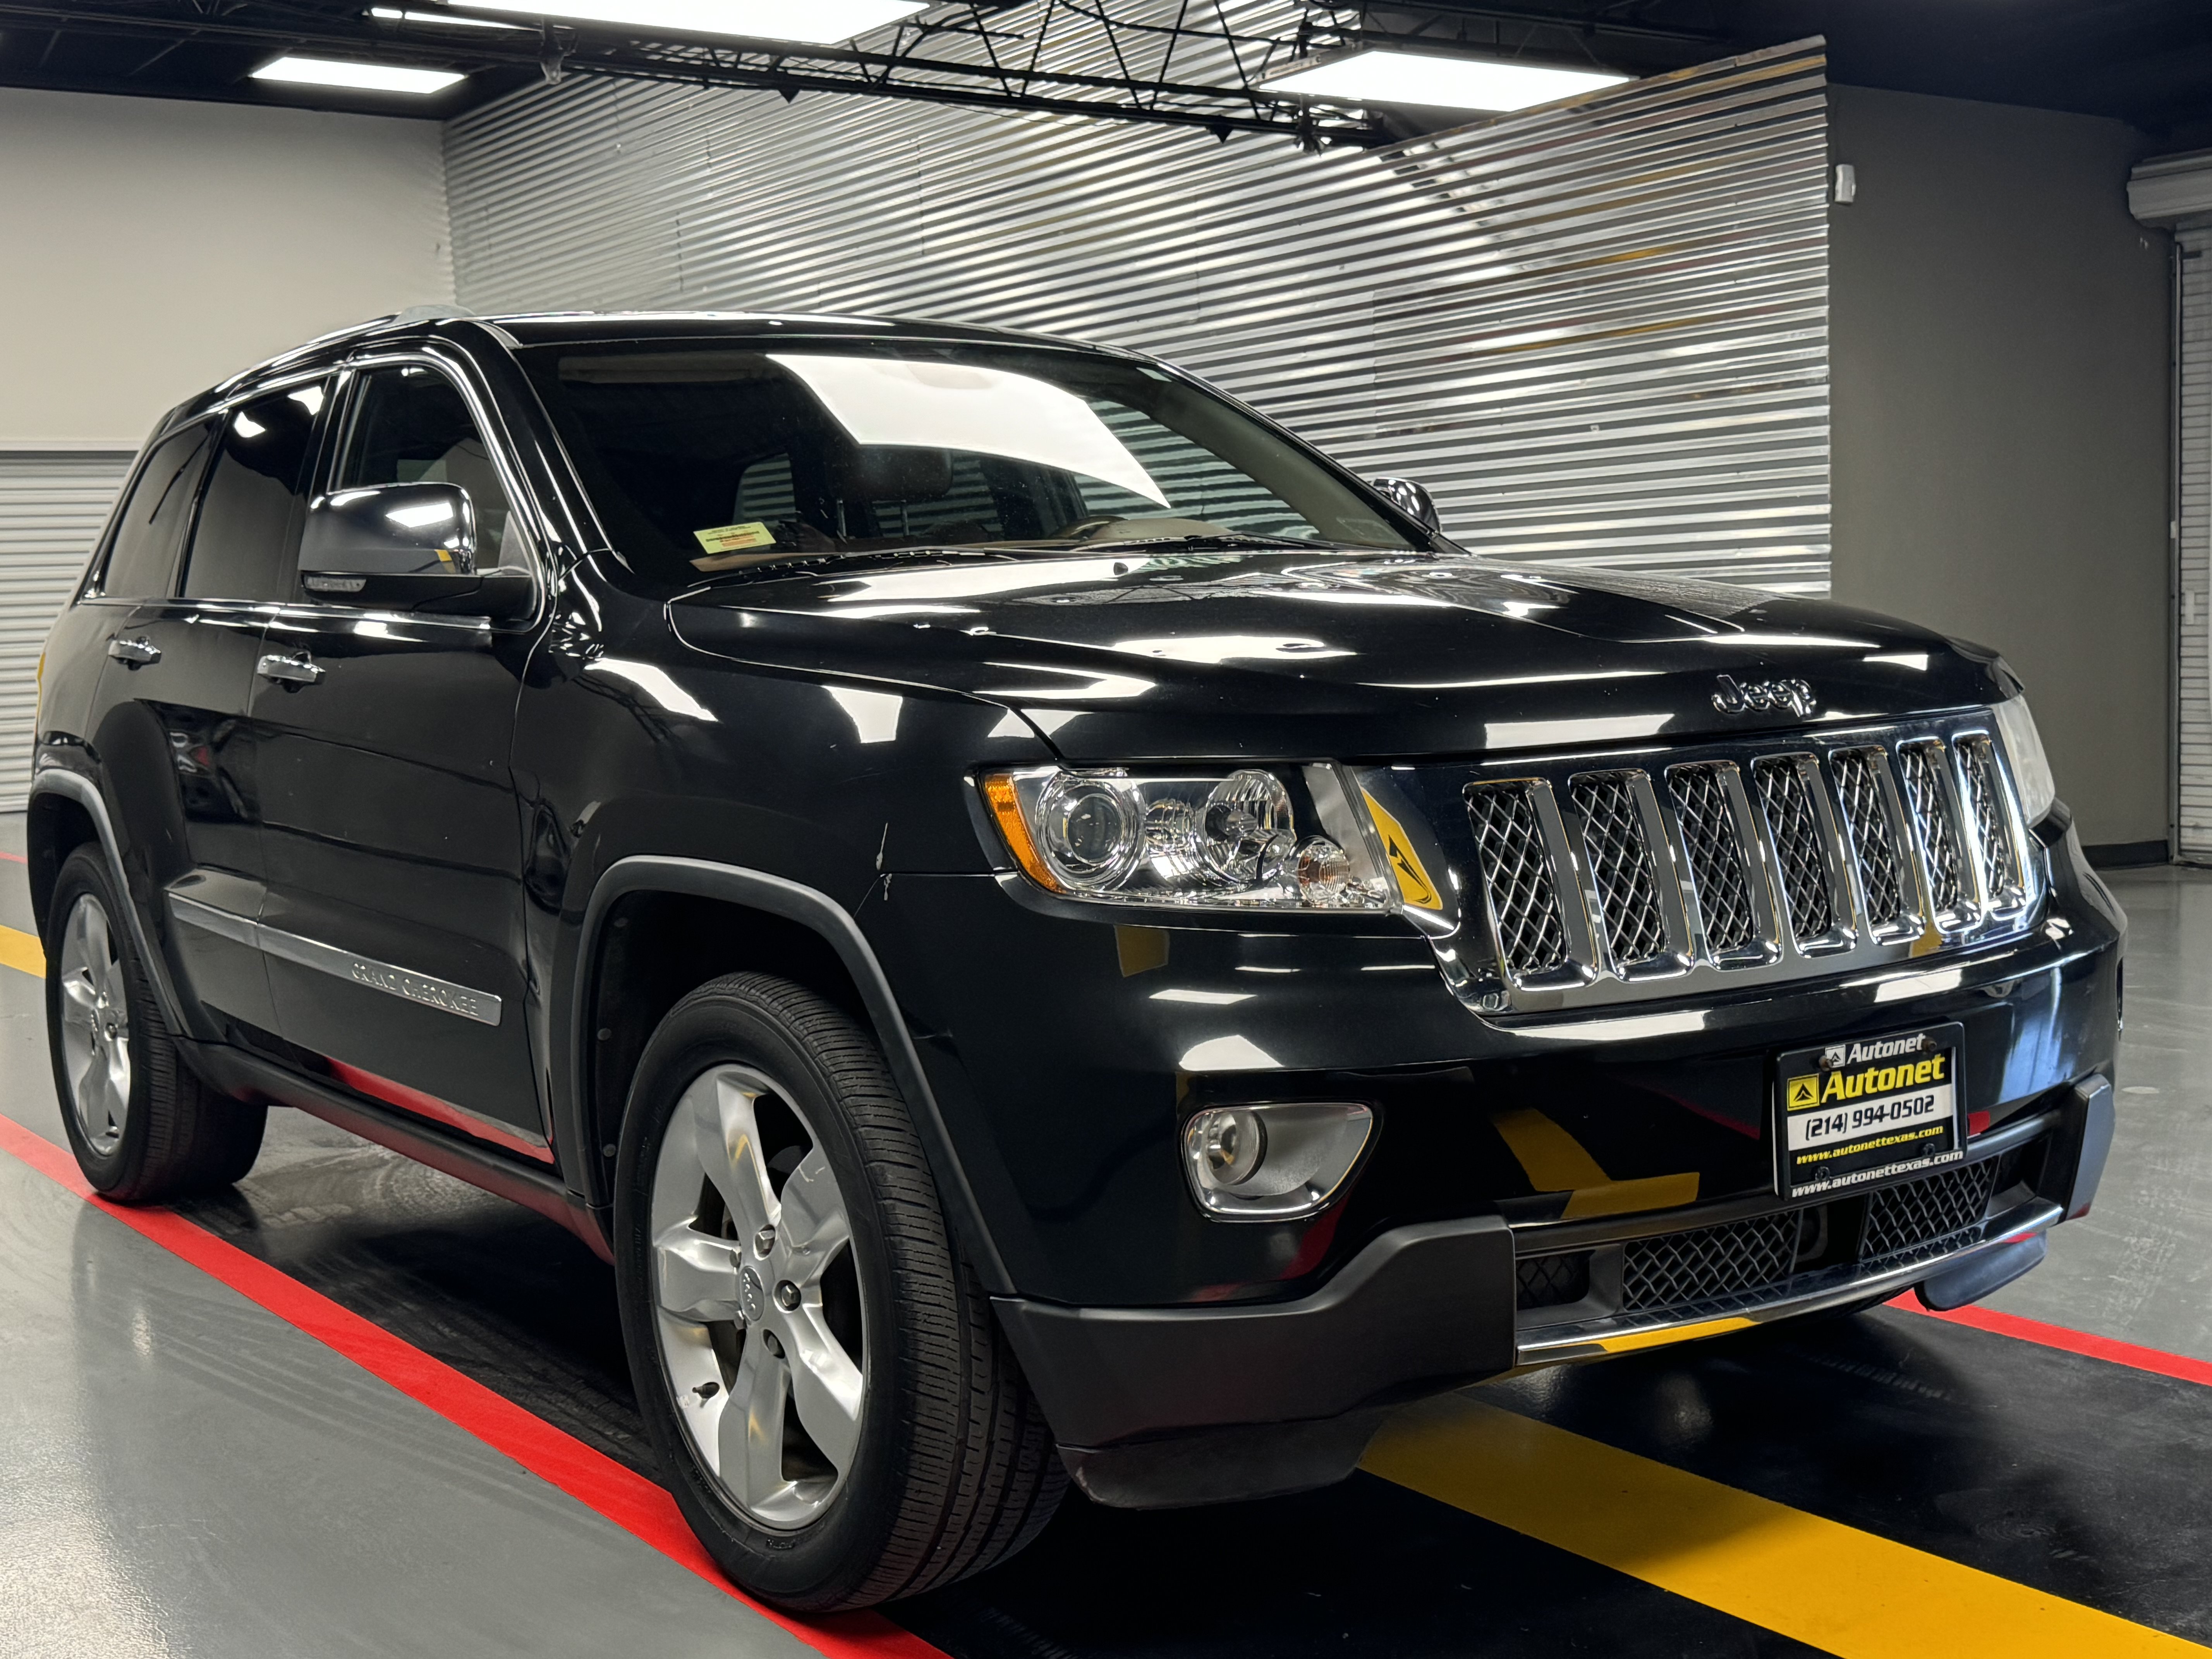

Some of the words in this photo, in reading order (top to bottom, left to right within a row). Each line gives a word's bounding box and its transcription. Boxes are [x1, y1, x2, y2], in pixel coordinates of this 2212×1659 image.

[1711, 675, 1817, 717] Jeep
[1846, 1033, 1925, 1064] Autonet
[1821, 1053, 1945, 1103] Autonet
[1805, 1112, 1848, 1140] (214)
[1852, 1095, 1934, 1128] 994-0502
[1796, 1125, 1943, 1164] www.autonettexas.com
[1791, 1151, 1963, 1197] www.autonettexas.com
